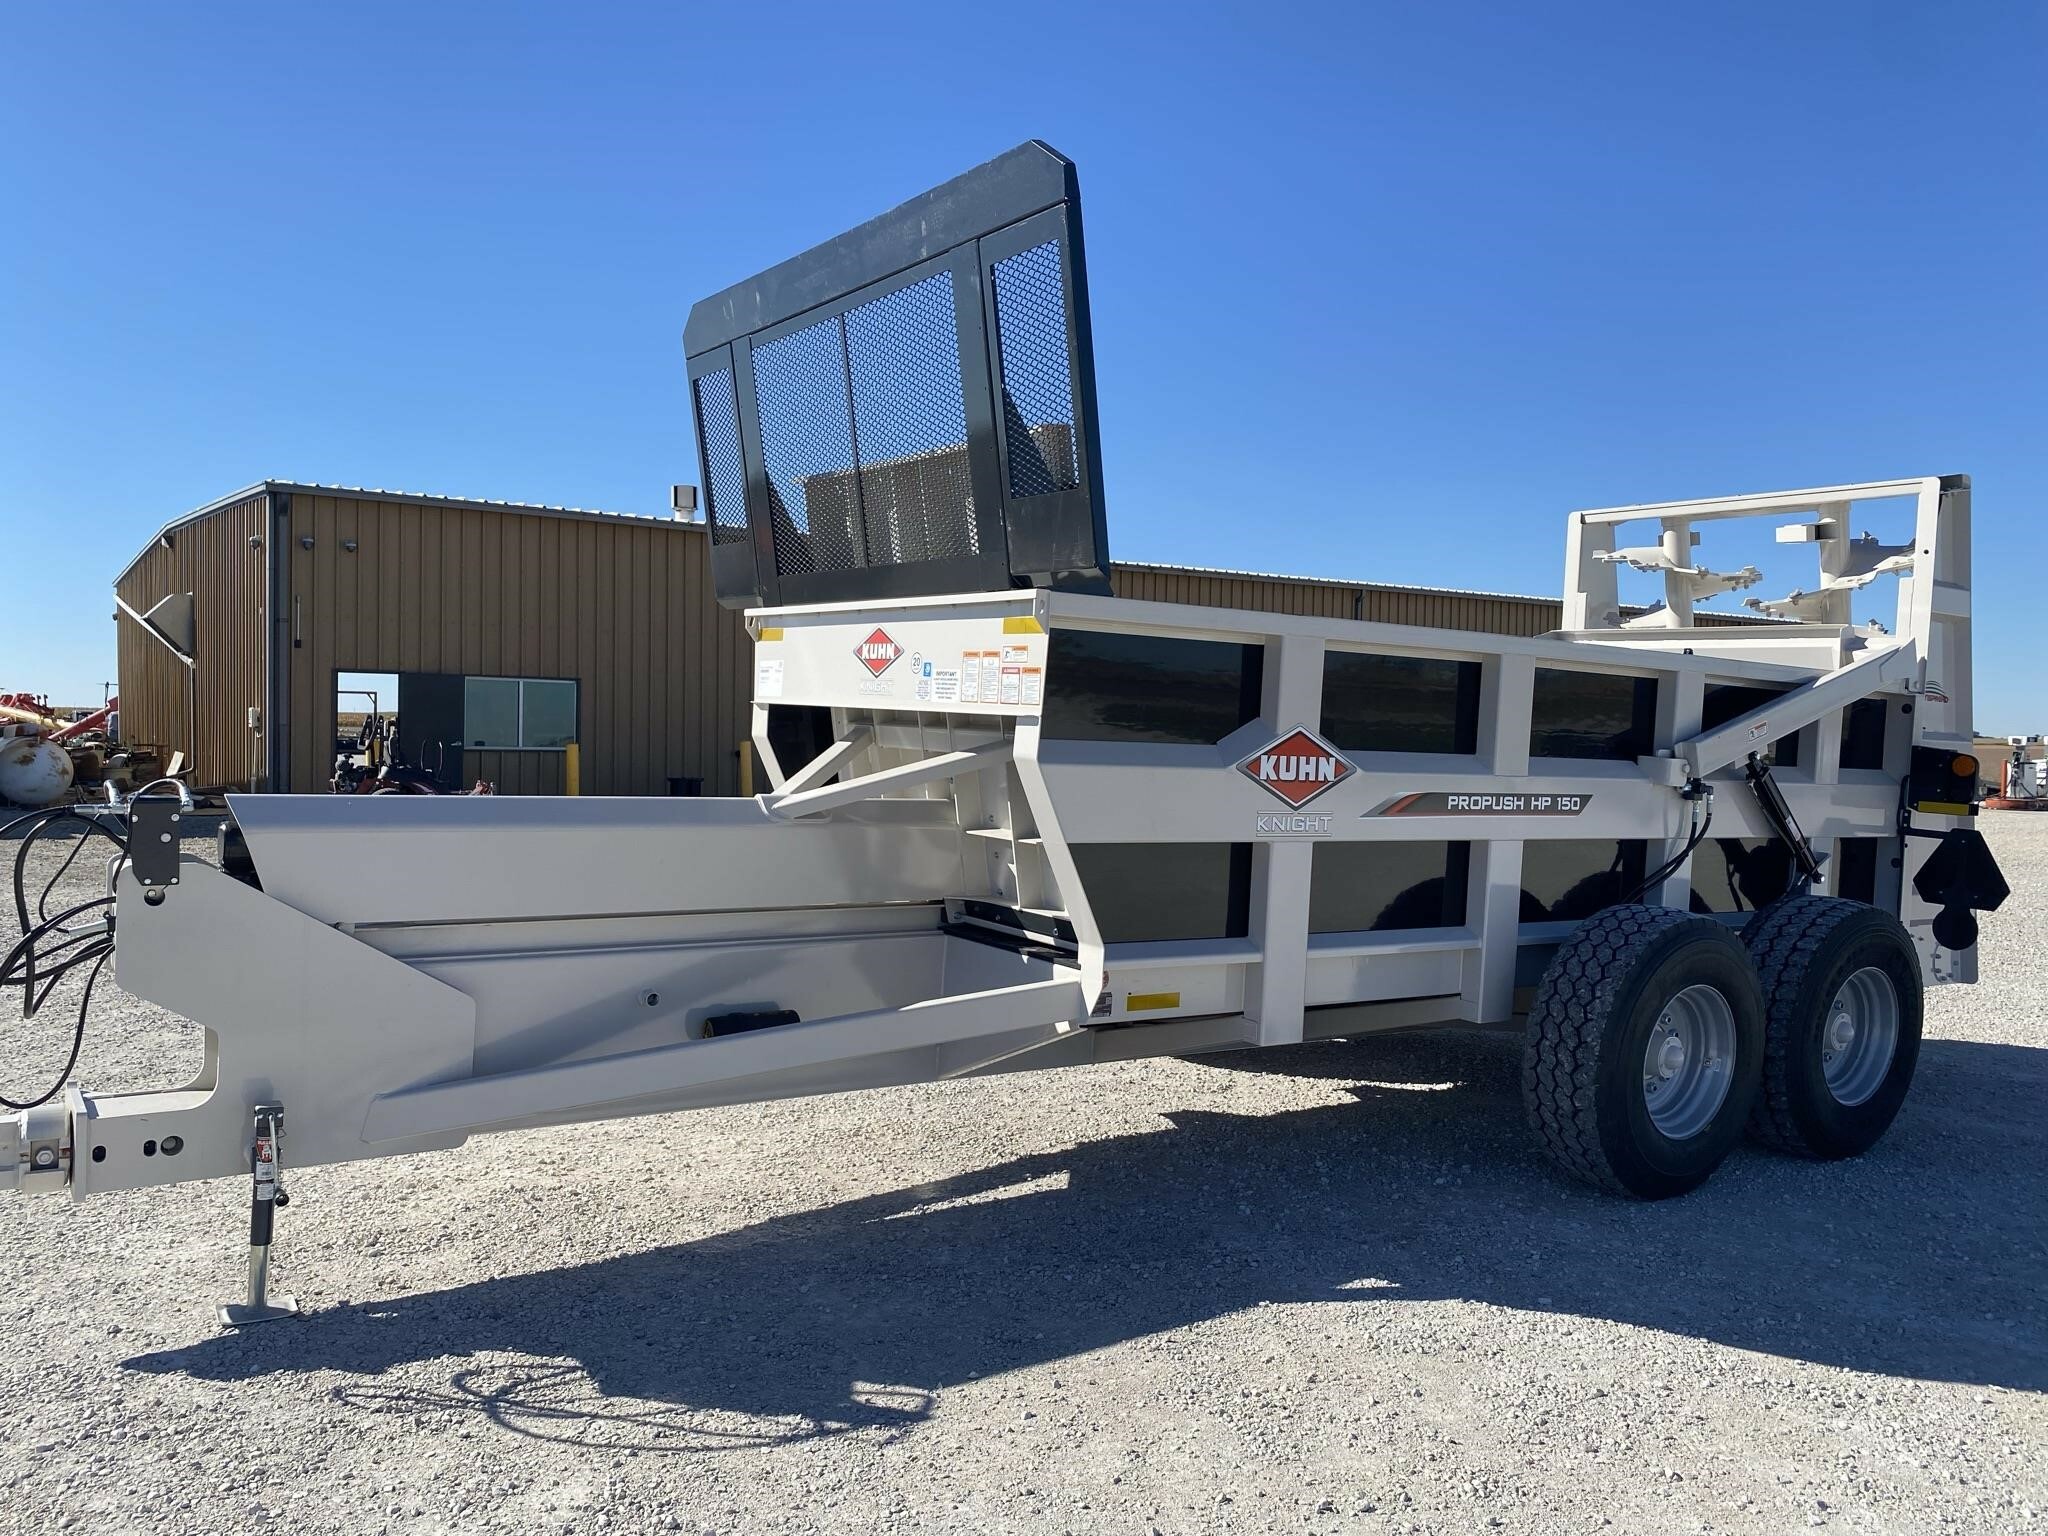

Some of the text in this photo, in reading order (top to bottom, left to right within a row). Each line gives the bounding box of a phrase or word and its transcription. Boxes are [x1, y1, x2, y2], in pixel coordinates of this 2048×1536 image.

[861, 643, 895, 660] KUHN
[1259, 754, 1336, 782] KUHN
[1447, 795, 1581, 811] PROPUSH HP 150
[1256, 816, 1333, 833] KNIGHT
